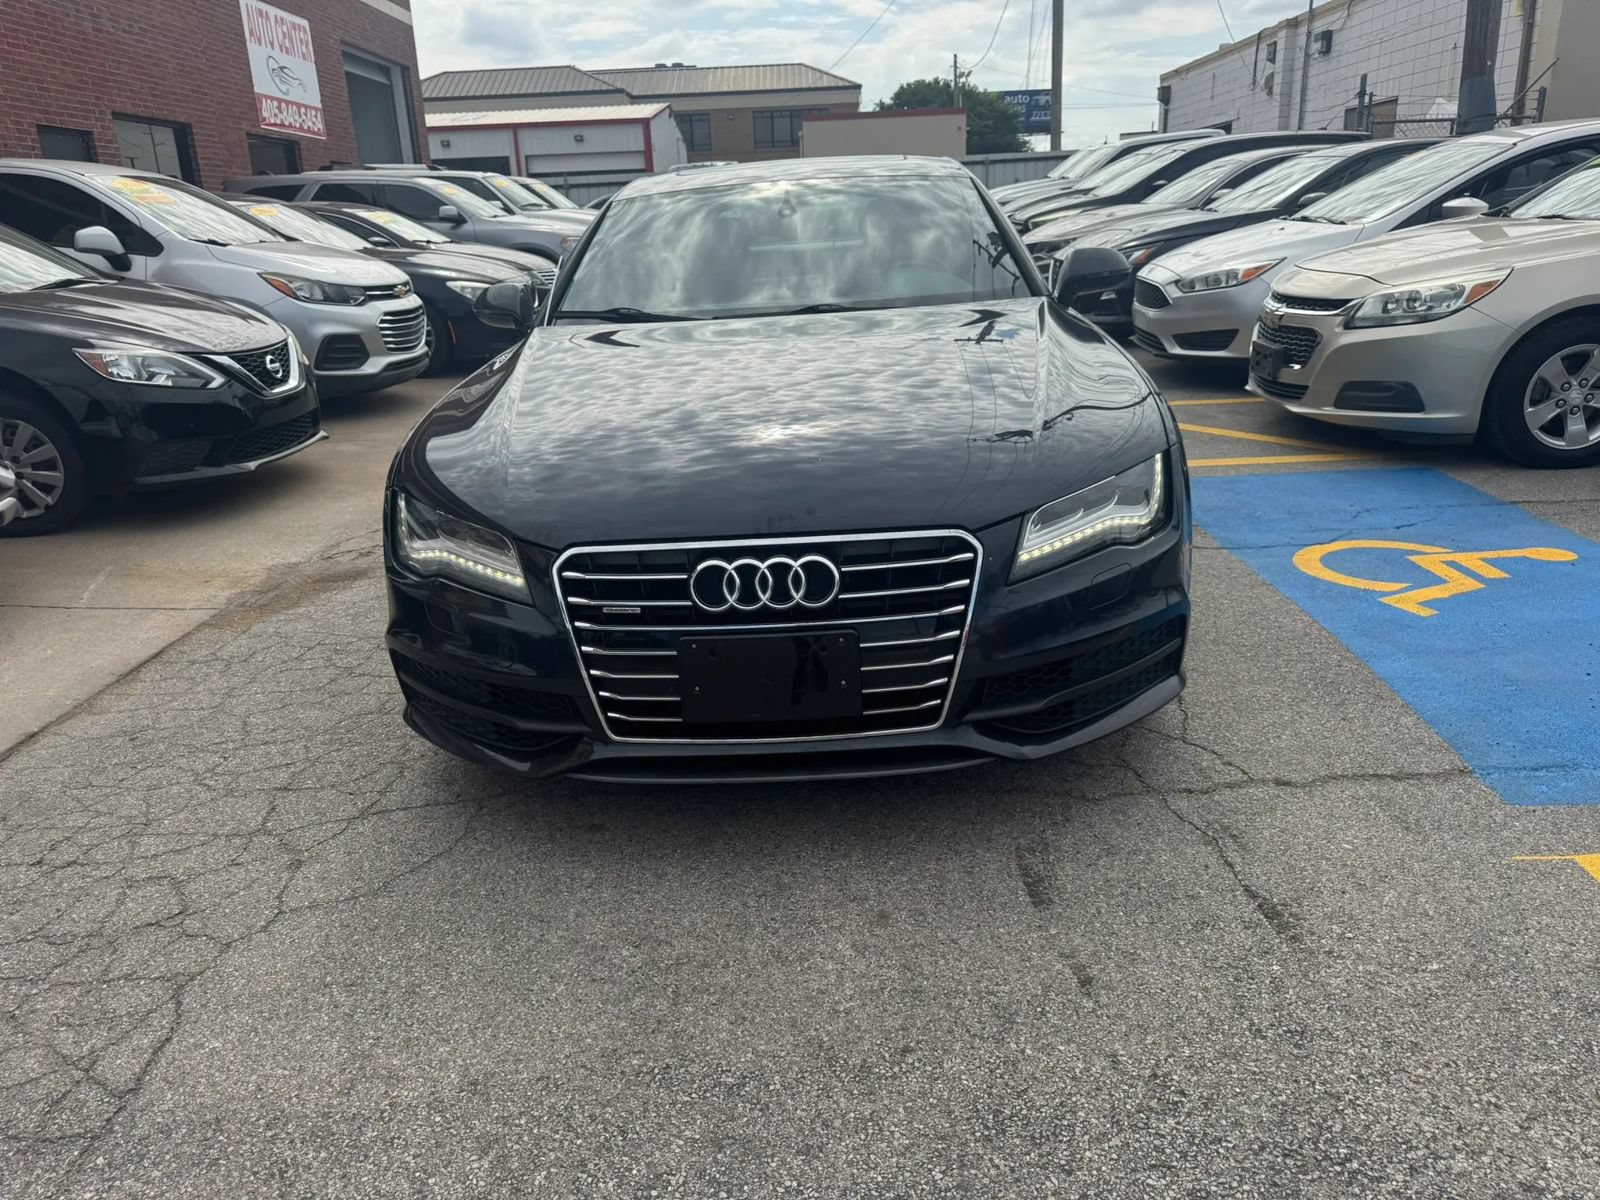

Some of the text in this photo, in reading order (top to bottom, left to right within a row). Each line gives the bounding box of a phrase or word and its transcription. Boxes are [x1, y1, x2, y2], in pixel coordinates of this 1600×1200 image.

[245, 3, 315, 63] AUTO CENTER
[261, 97, 324, 133] 405-849-5454
[1004, 94, 1030, 104] auto
